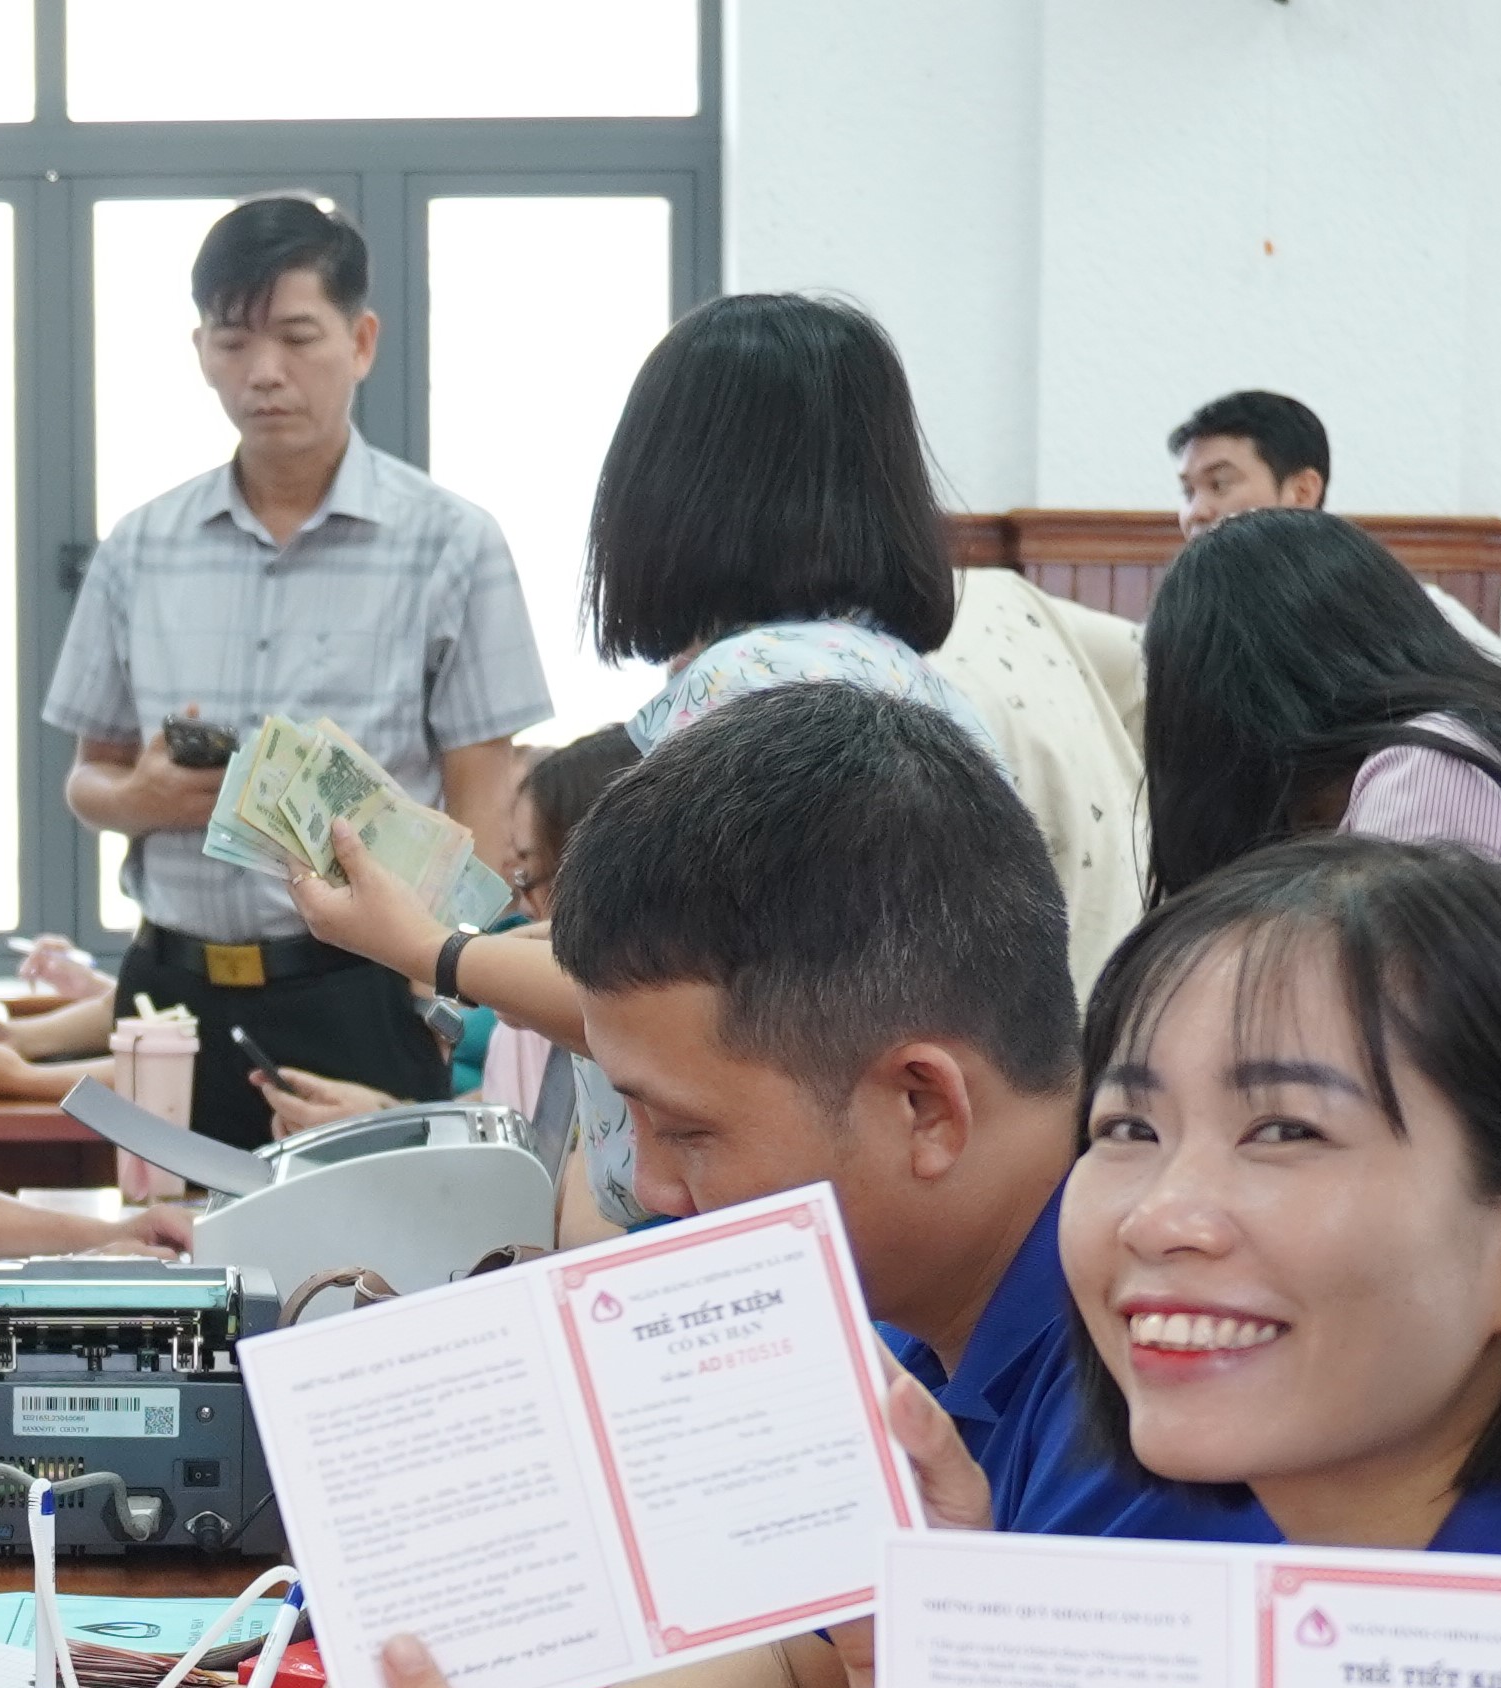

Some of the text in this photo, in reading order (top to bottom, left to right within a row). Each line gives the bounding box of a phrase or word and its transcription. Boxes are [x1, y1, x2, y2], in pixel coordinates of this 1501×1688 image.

[632, 1288, 784, 1341] THẺ TIẾT KIỆM
[1340, 1656, 1391, 1685] THẺ
